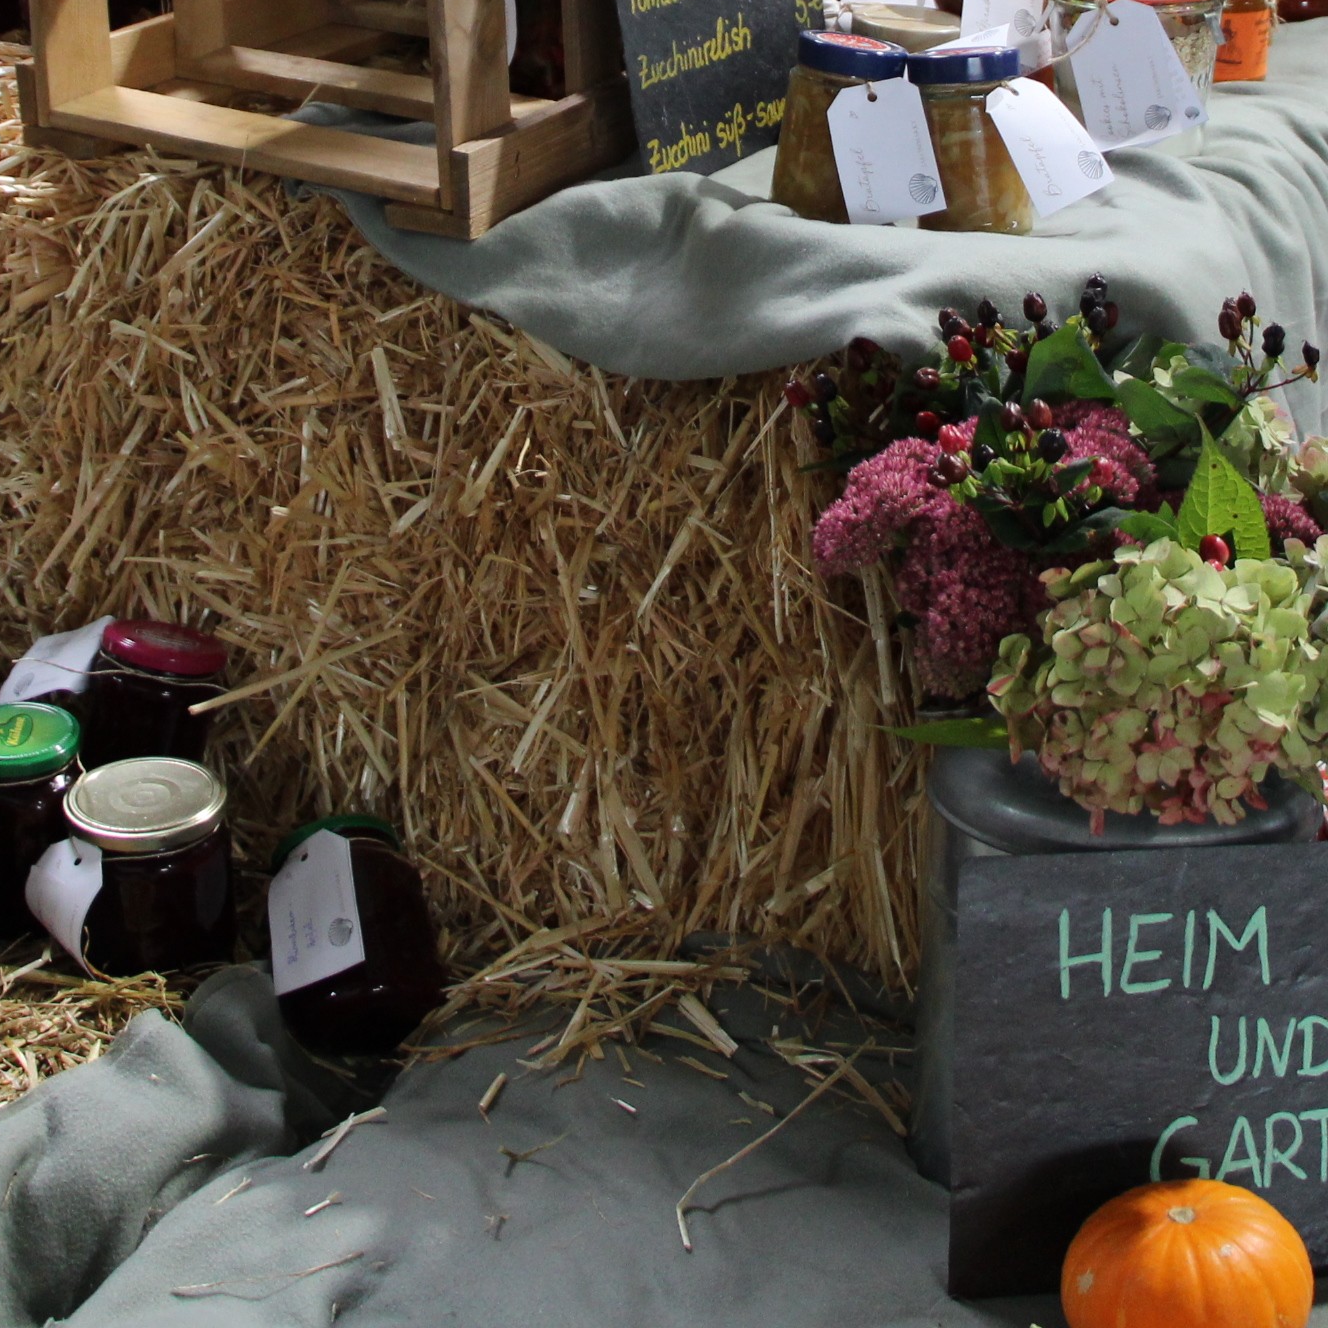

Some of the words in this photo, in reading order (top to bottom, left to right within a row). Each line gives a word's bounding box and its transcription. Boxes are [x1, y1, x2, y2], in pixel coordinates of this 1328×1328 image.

[637, 12, 752, 90] Zucchinirelish
[647, 120, 711, 174] Zucchini
[1058, 905, 1271, 999] HEIM
